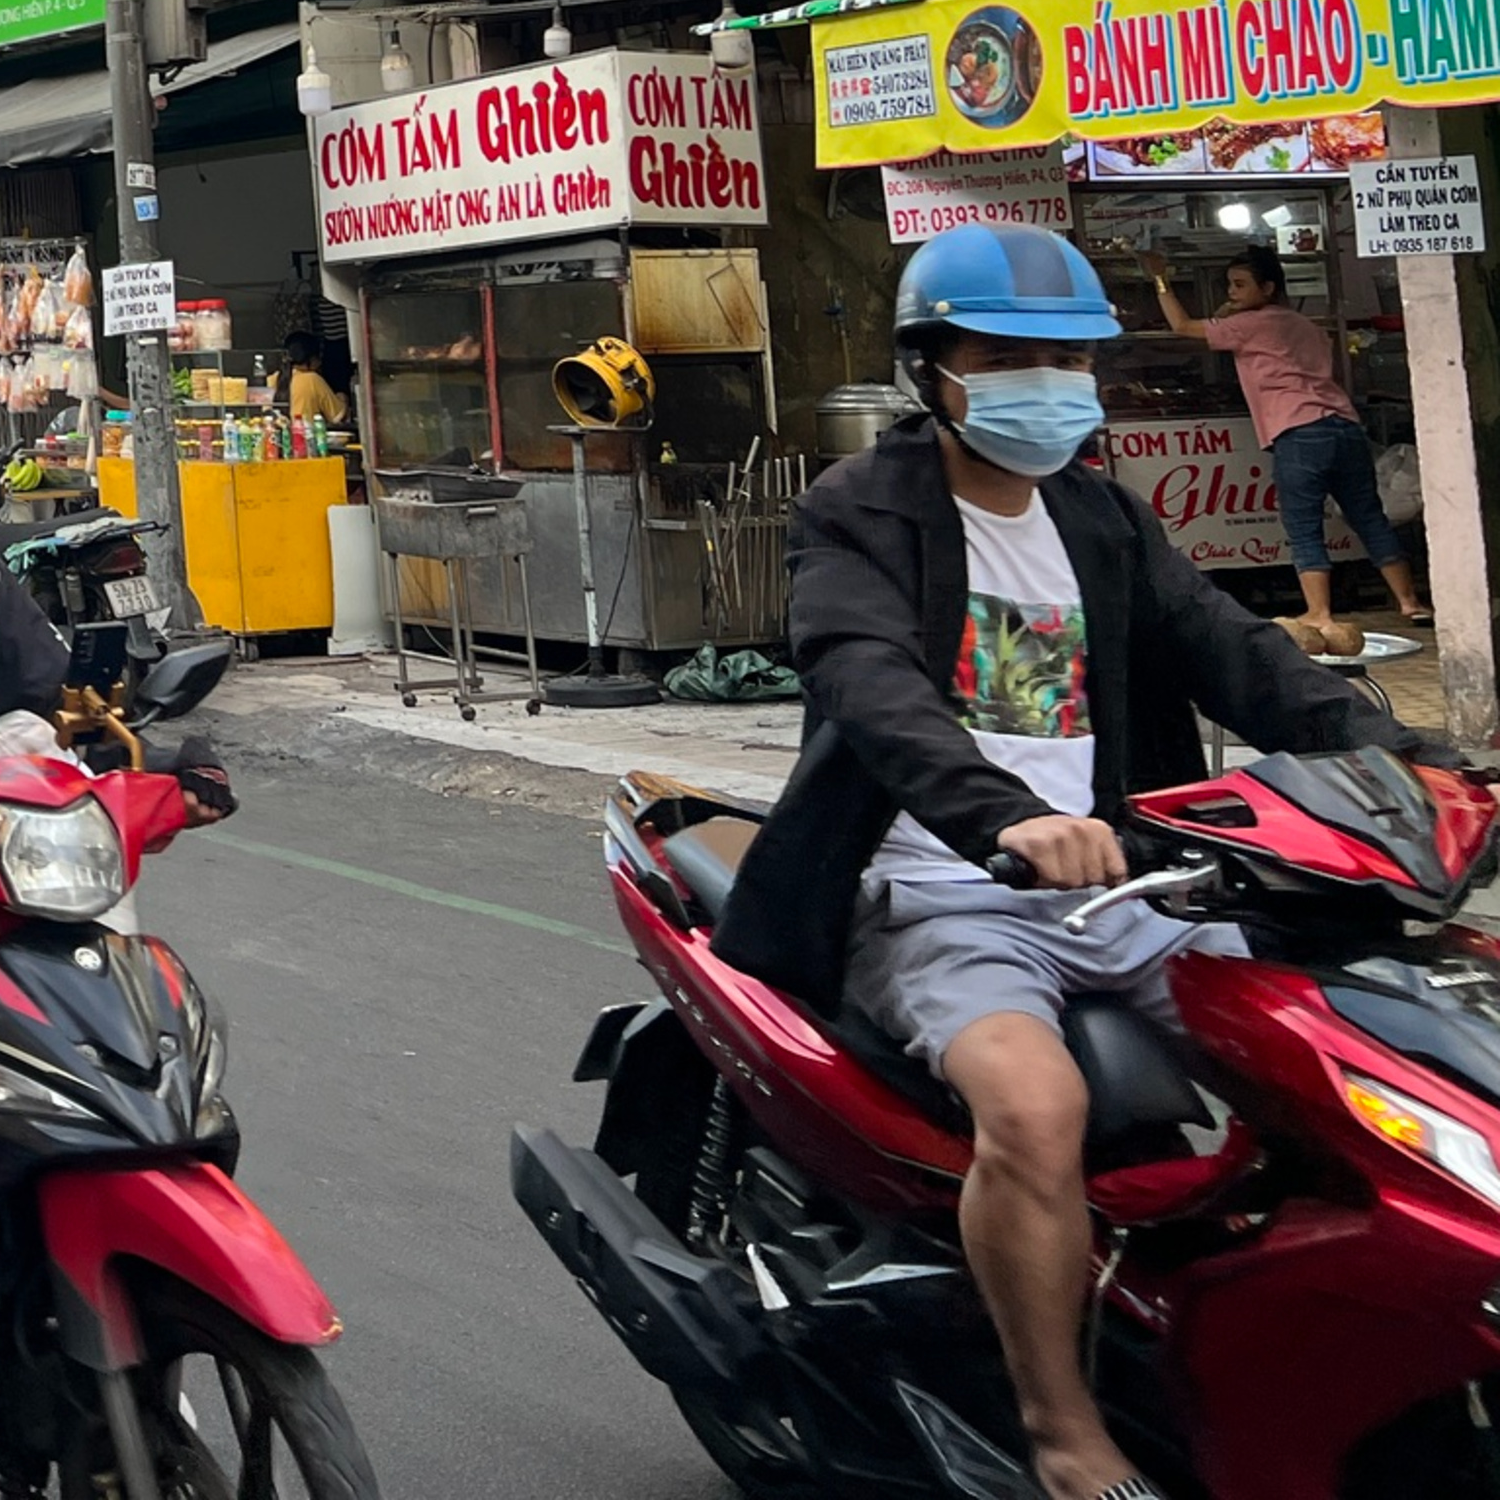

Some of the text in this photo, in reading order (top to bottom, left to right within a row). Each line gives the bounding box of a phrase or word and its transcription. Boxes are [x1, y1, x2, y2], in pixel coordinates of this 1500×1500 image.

[1064, 0, 1174, 116] BÁNH
[628, 65, 686, 128] CƠM
[321, 65, 609, 190] CƠM TẤM Ghiền
[628, 134, 761, 210] Ghiền
[907, 180, 924, 194] 206
[926, 174, 964, 196] Nguyễn
[964, 173, 1001, 192] Thượng
[1050, 167, 1064, 183] Q3
[1409, 156, 1459, 182] TUYỂN
[325, 198, 365, 247] SƯỜN
[367, 191, 419, 239] NƯỚNG
[421, 187, 453, 236] MẬT
[456, 188, 491, 228] ONG
[525, 175, 546, 219] LÀ
[552, 164, 610, 215] Ghiền
[1356, 184, 1479, 211] 2 NỮ PHỤ QUÁN CƠM
[894, 209, 927, 235] ĐT:
[931, 204, 980, 233] 0393
[1027, 197, 1067, 224] 778
[1380, 212, 1460, 233] LÀM THEO CA
[1393, 237, 1424, 253] 0935
[1427, 237, 1448, 251] 187
[1451, 235, 1473, 251] 618
[1110, 422, 1233, 458] CƠM TẤM
[1240, 537, 1282, 564] Quý
